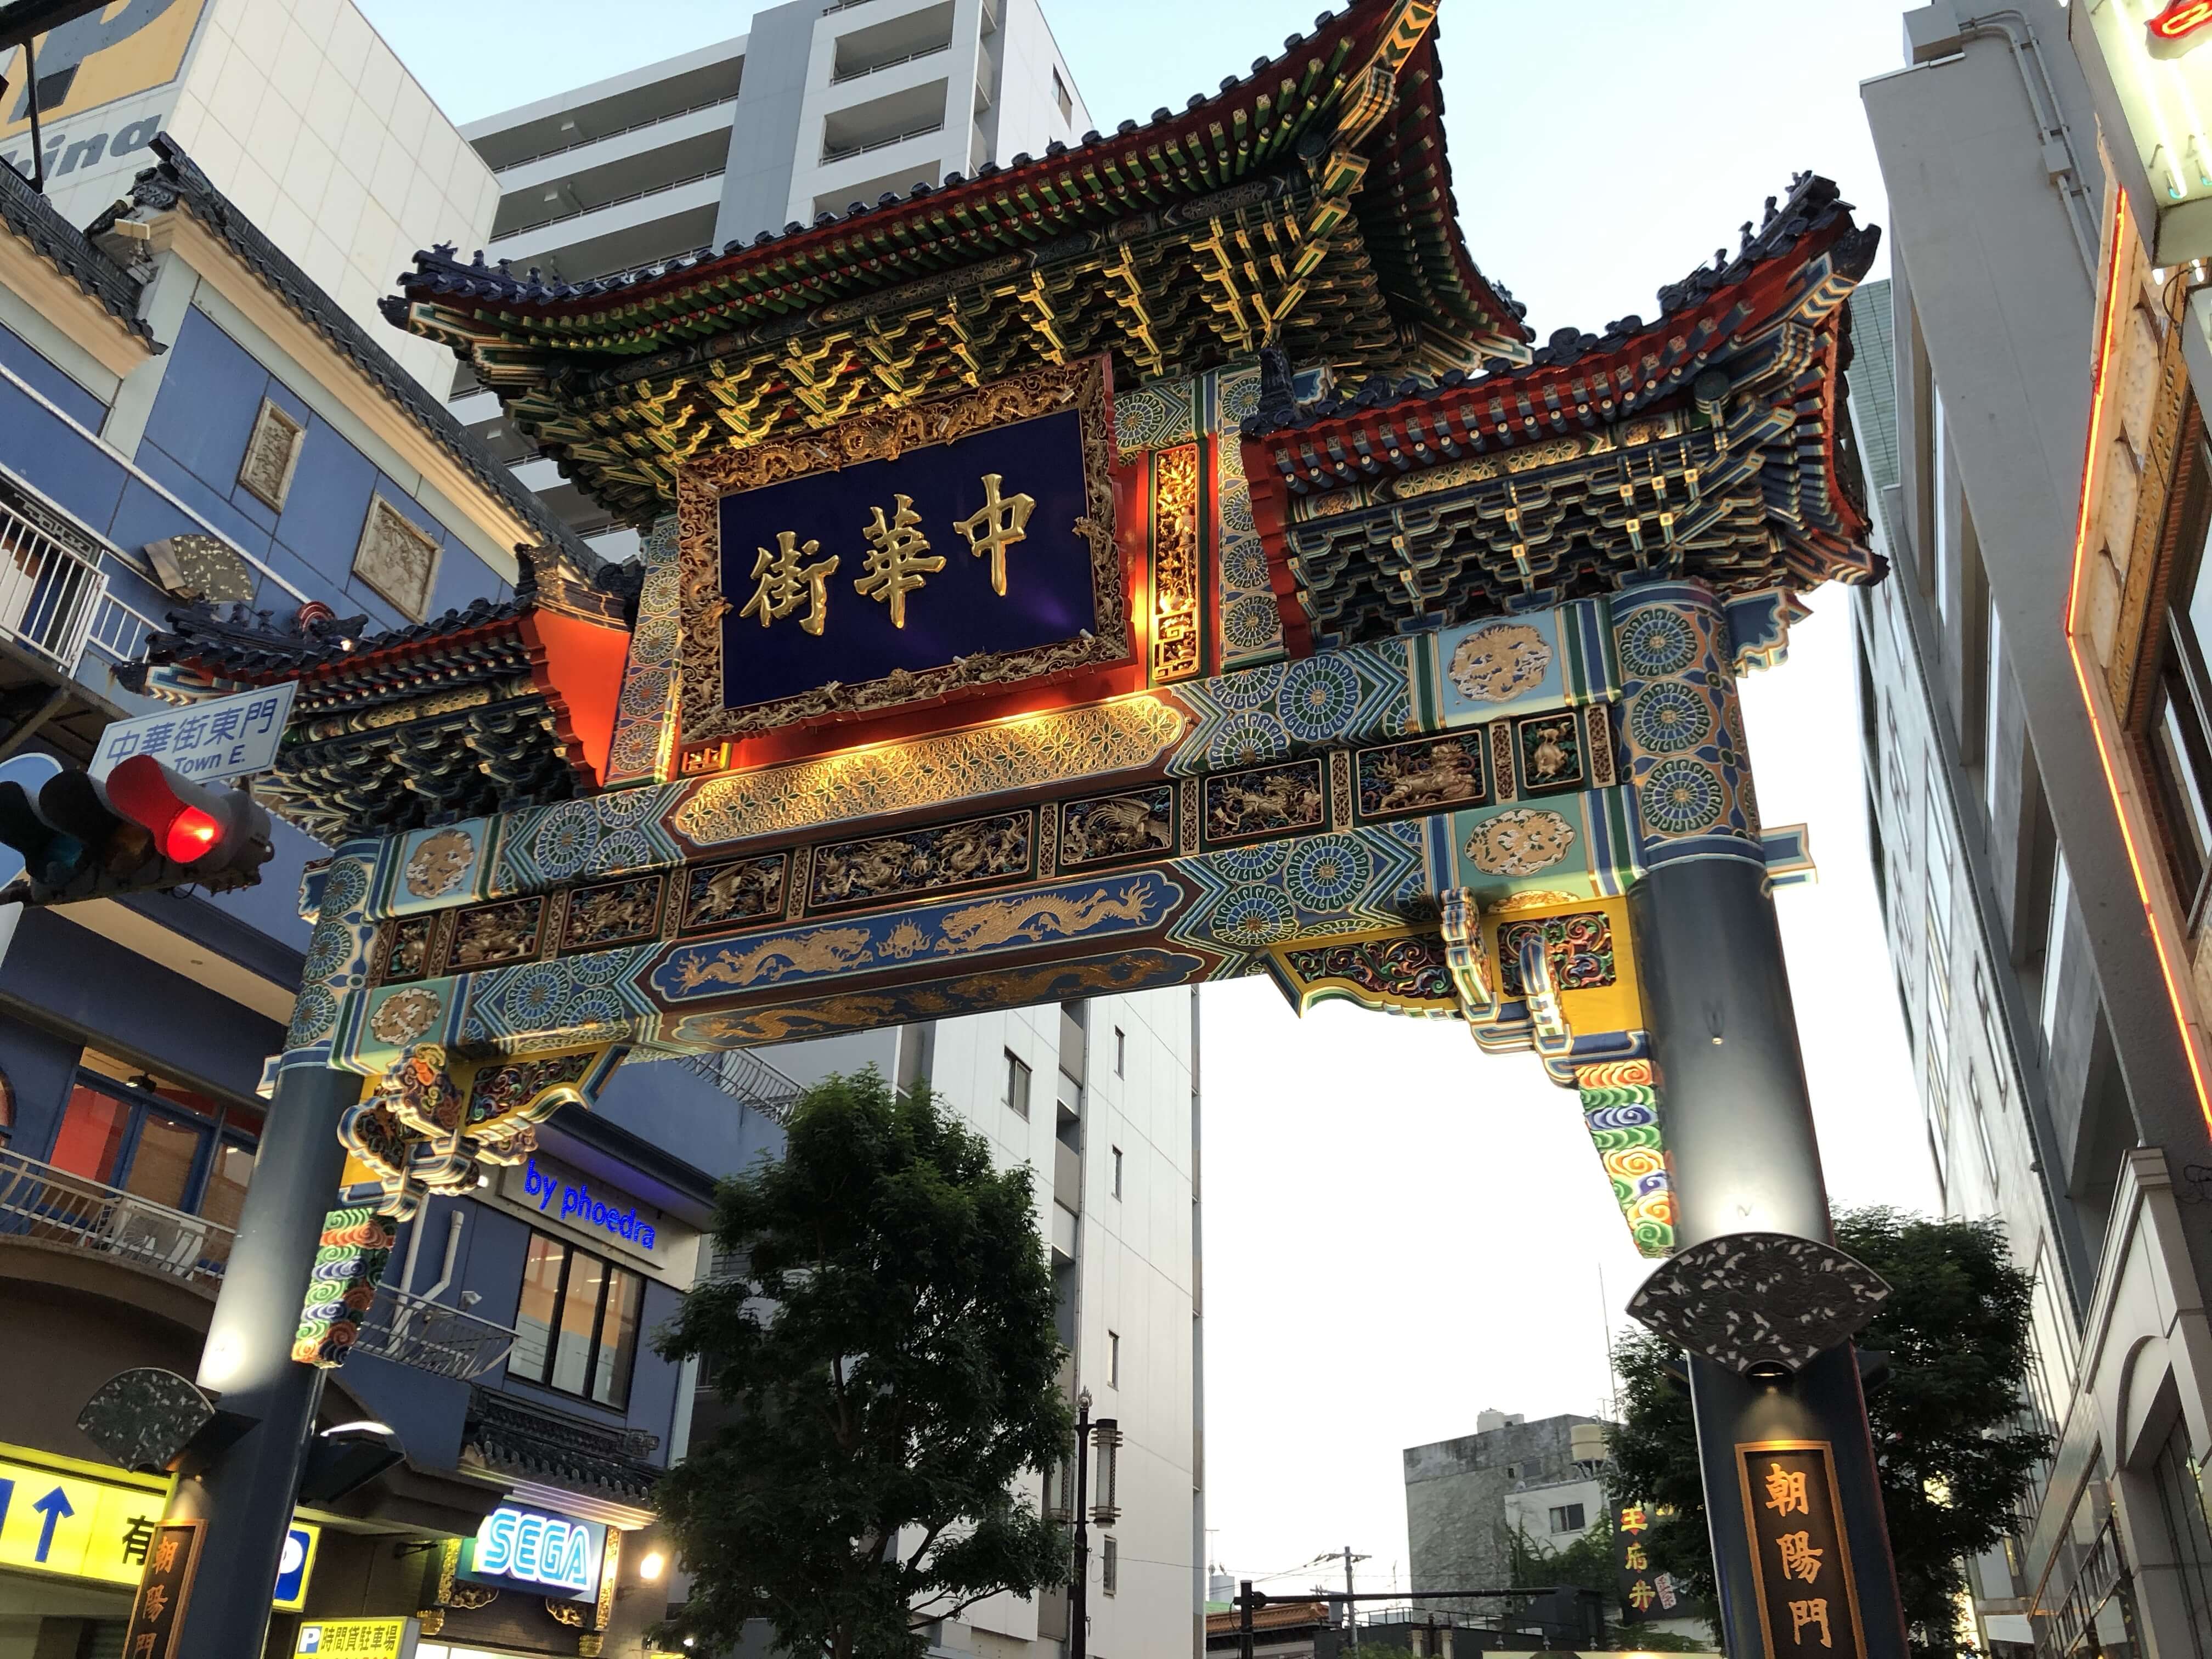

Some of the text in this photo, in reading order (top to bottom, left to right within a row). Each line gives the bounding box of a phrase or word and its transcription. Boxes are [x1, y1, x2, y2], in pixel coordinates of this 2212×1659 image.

[740, 473, 1036, 636] 中華街
[106, 698, 278, 766] 中華街東門
[173, 744, 246, 775] Town E.
[524, 1158, 656, 1251] by phoedra
[481, 1510, 589, 1589] SEGA
[1620, 1505, 1656, 1608] 王府井
[1765, 1463, 1832, 1649] 朝陽門
[133, 1536, 179, 1659] 朝陽門
[321, 1626, 398, 1652] 時間貸駐車場
